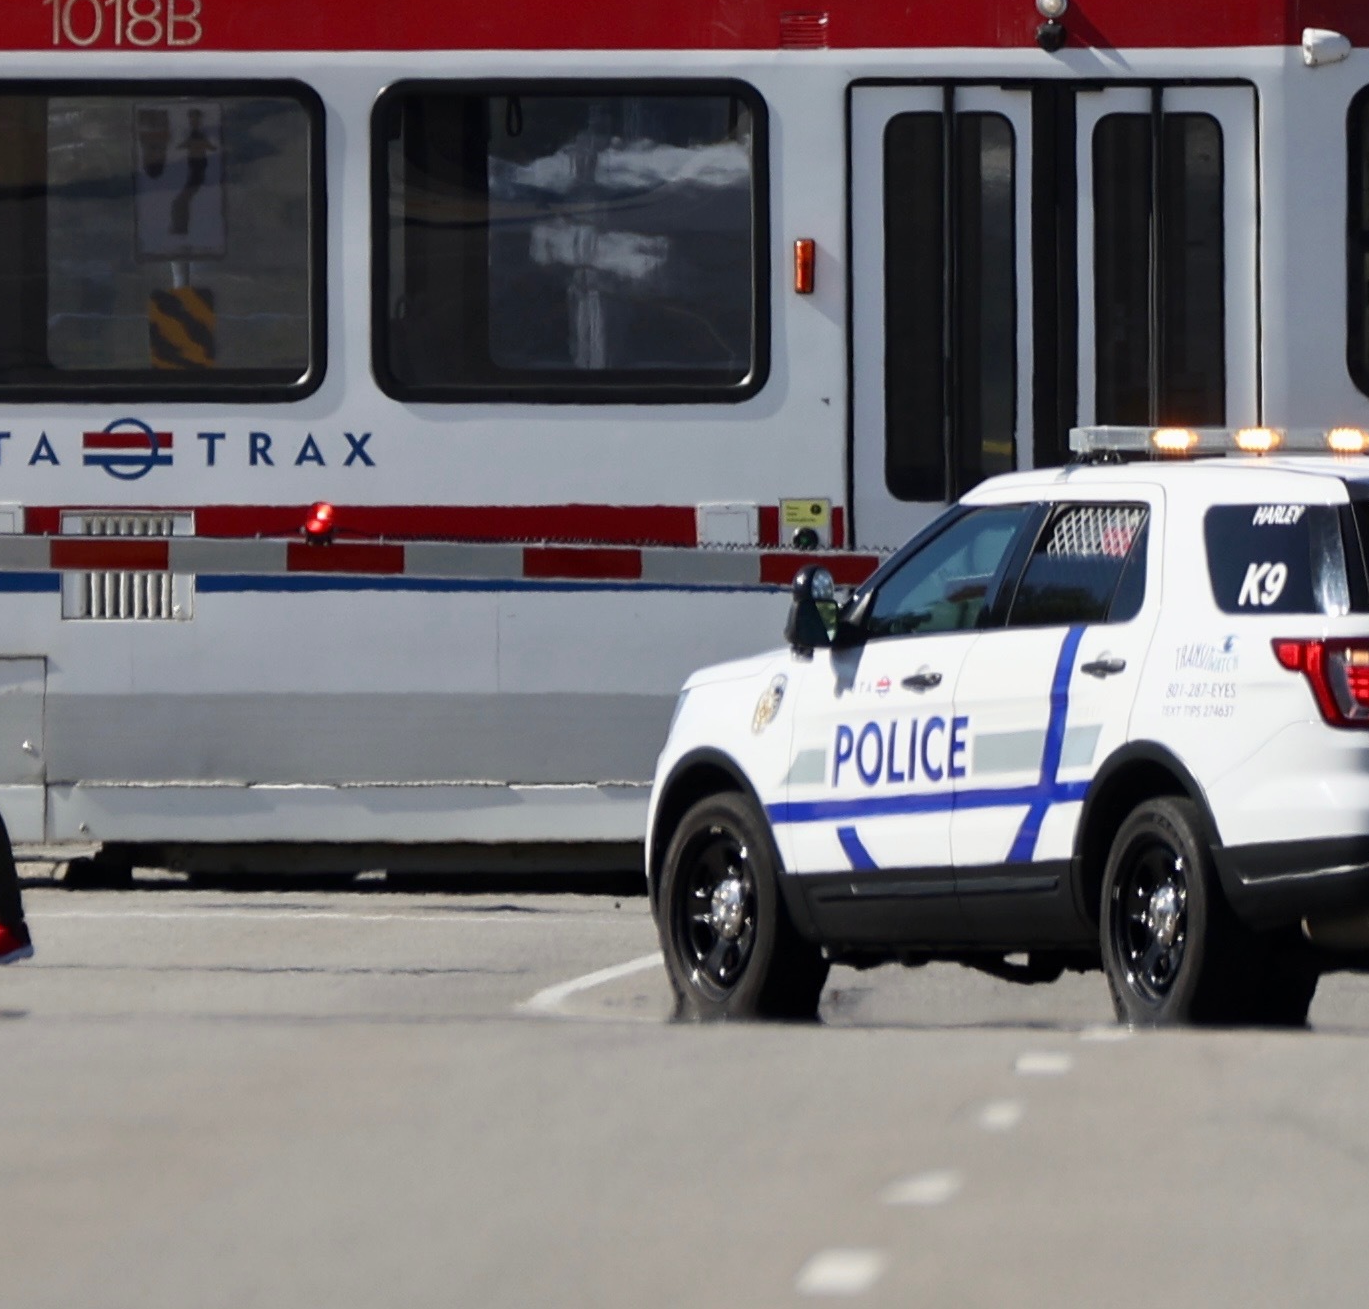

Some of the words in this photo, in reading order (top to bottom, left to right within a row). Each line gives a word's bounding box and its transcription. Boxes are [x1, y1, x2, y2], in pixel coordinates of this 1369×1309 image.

[197, 431, 377, 467] TRAX
[1252, 505, 1305, 526] HARLEY
[1238, 561, 1288, 607] K9
[831, 715, 969, 788] POLICE
